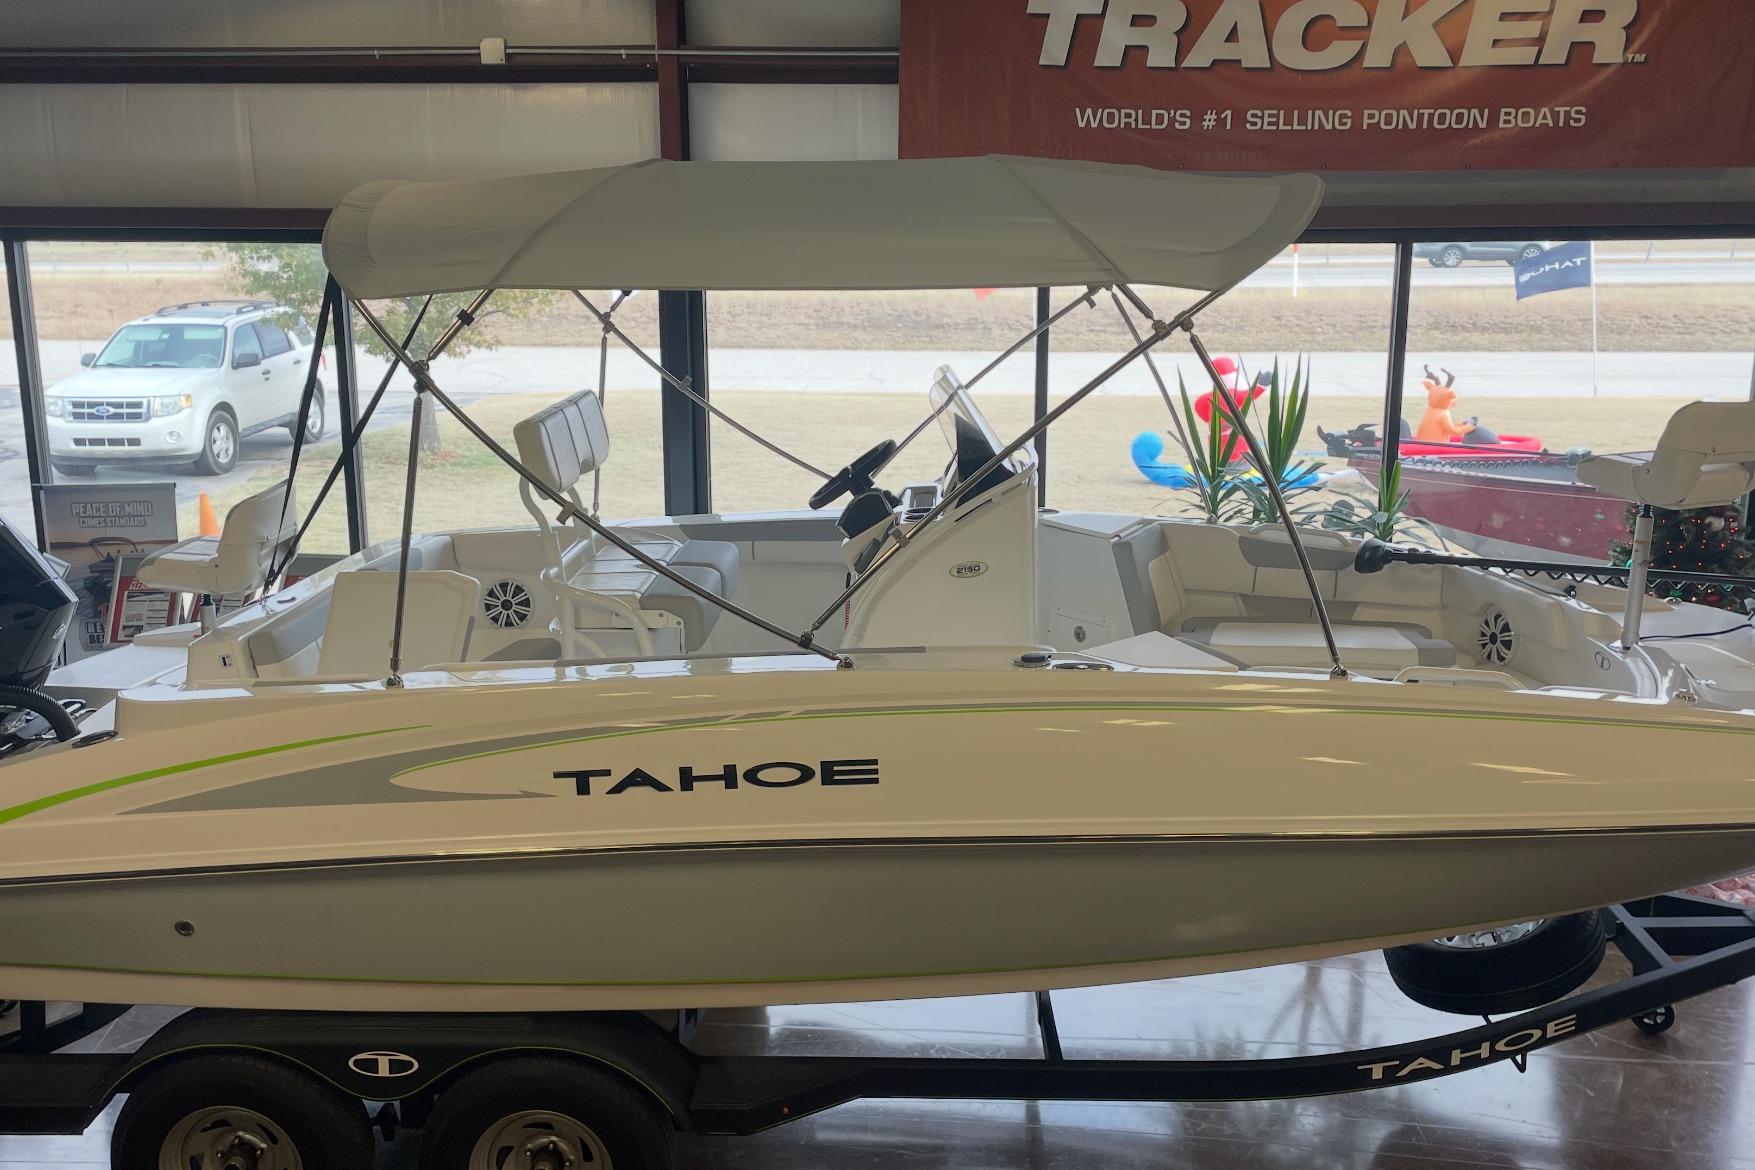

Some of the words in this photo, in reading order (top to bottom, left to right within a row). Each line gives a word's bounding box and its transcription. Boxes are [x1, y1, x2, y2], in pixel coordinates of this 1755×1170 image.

[1026, 0, 1638, 70] TRACKER
[1075, 107, 1191, 130] WORLD'S
[1201, 109, 1233, 131] #1
[1245, 109, 1352, 131] SELLING
[1362, 108, 1489, 130] PONTOON
[1498, 106, 1587, 129] BOATS
[71, 502, 106, 518] PEACE
[108, 502, 122, 517] OF
[124, 501, 152, 517] MIND
[79, 516, 105, 527] COMES
[956, 565, 981, 574] 2150
[552, 758, 880, 796] TAHOE
[1357, 1013, 1577, 1080] TAHOE
